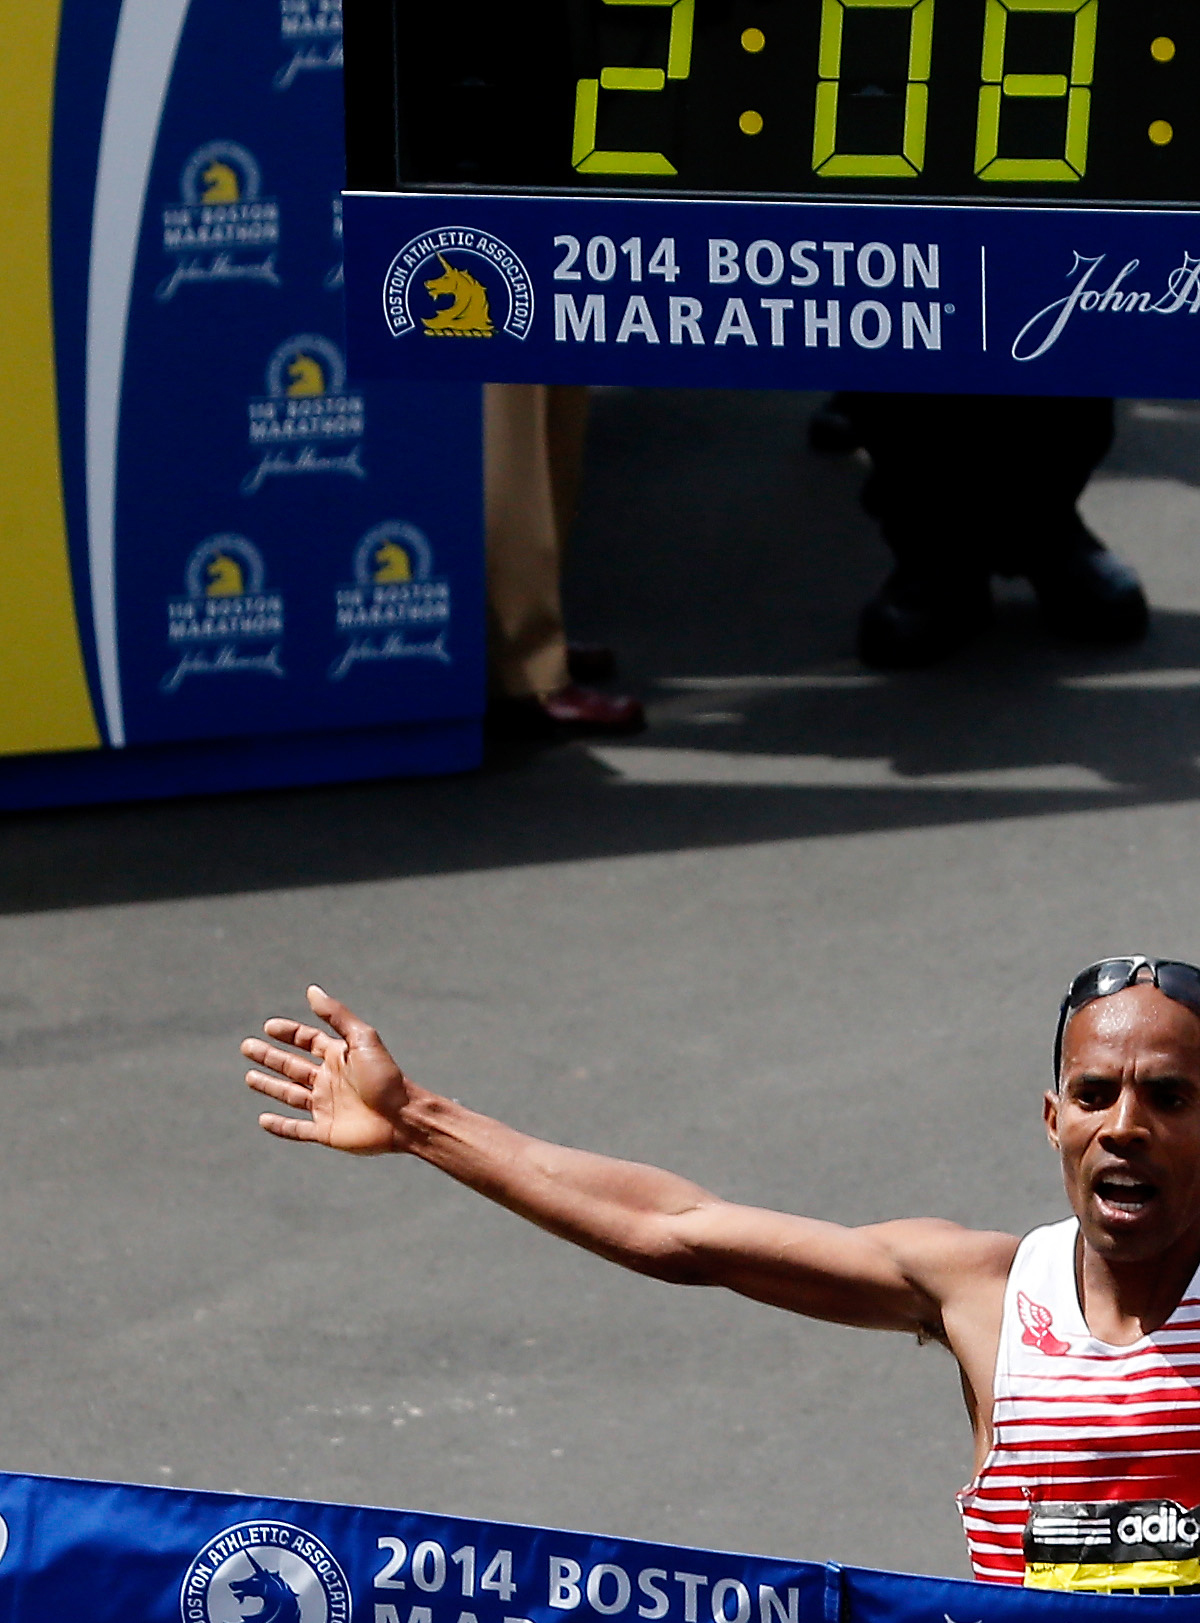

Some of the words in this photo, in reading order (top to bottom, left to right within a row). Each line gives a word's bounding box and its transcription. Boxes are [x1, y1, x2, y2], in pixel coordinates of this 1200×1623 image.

[389, 266, 408, 328] BOSTON
[402, 231, 475, 268] ATHLETIC
[476, 237, 529, 330] ASSOCIATION
[553, 235, 680, 284] 2014
[708, 239, 939, 289] BOSTON
[207, 1527, 290, 1566] ATHLETIC
[373, 1536, 516, 1601] 2014
